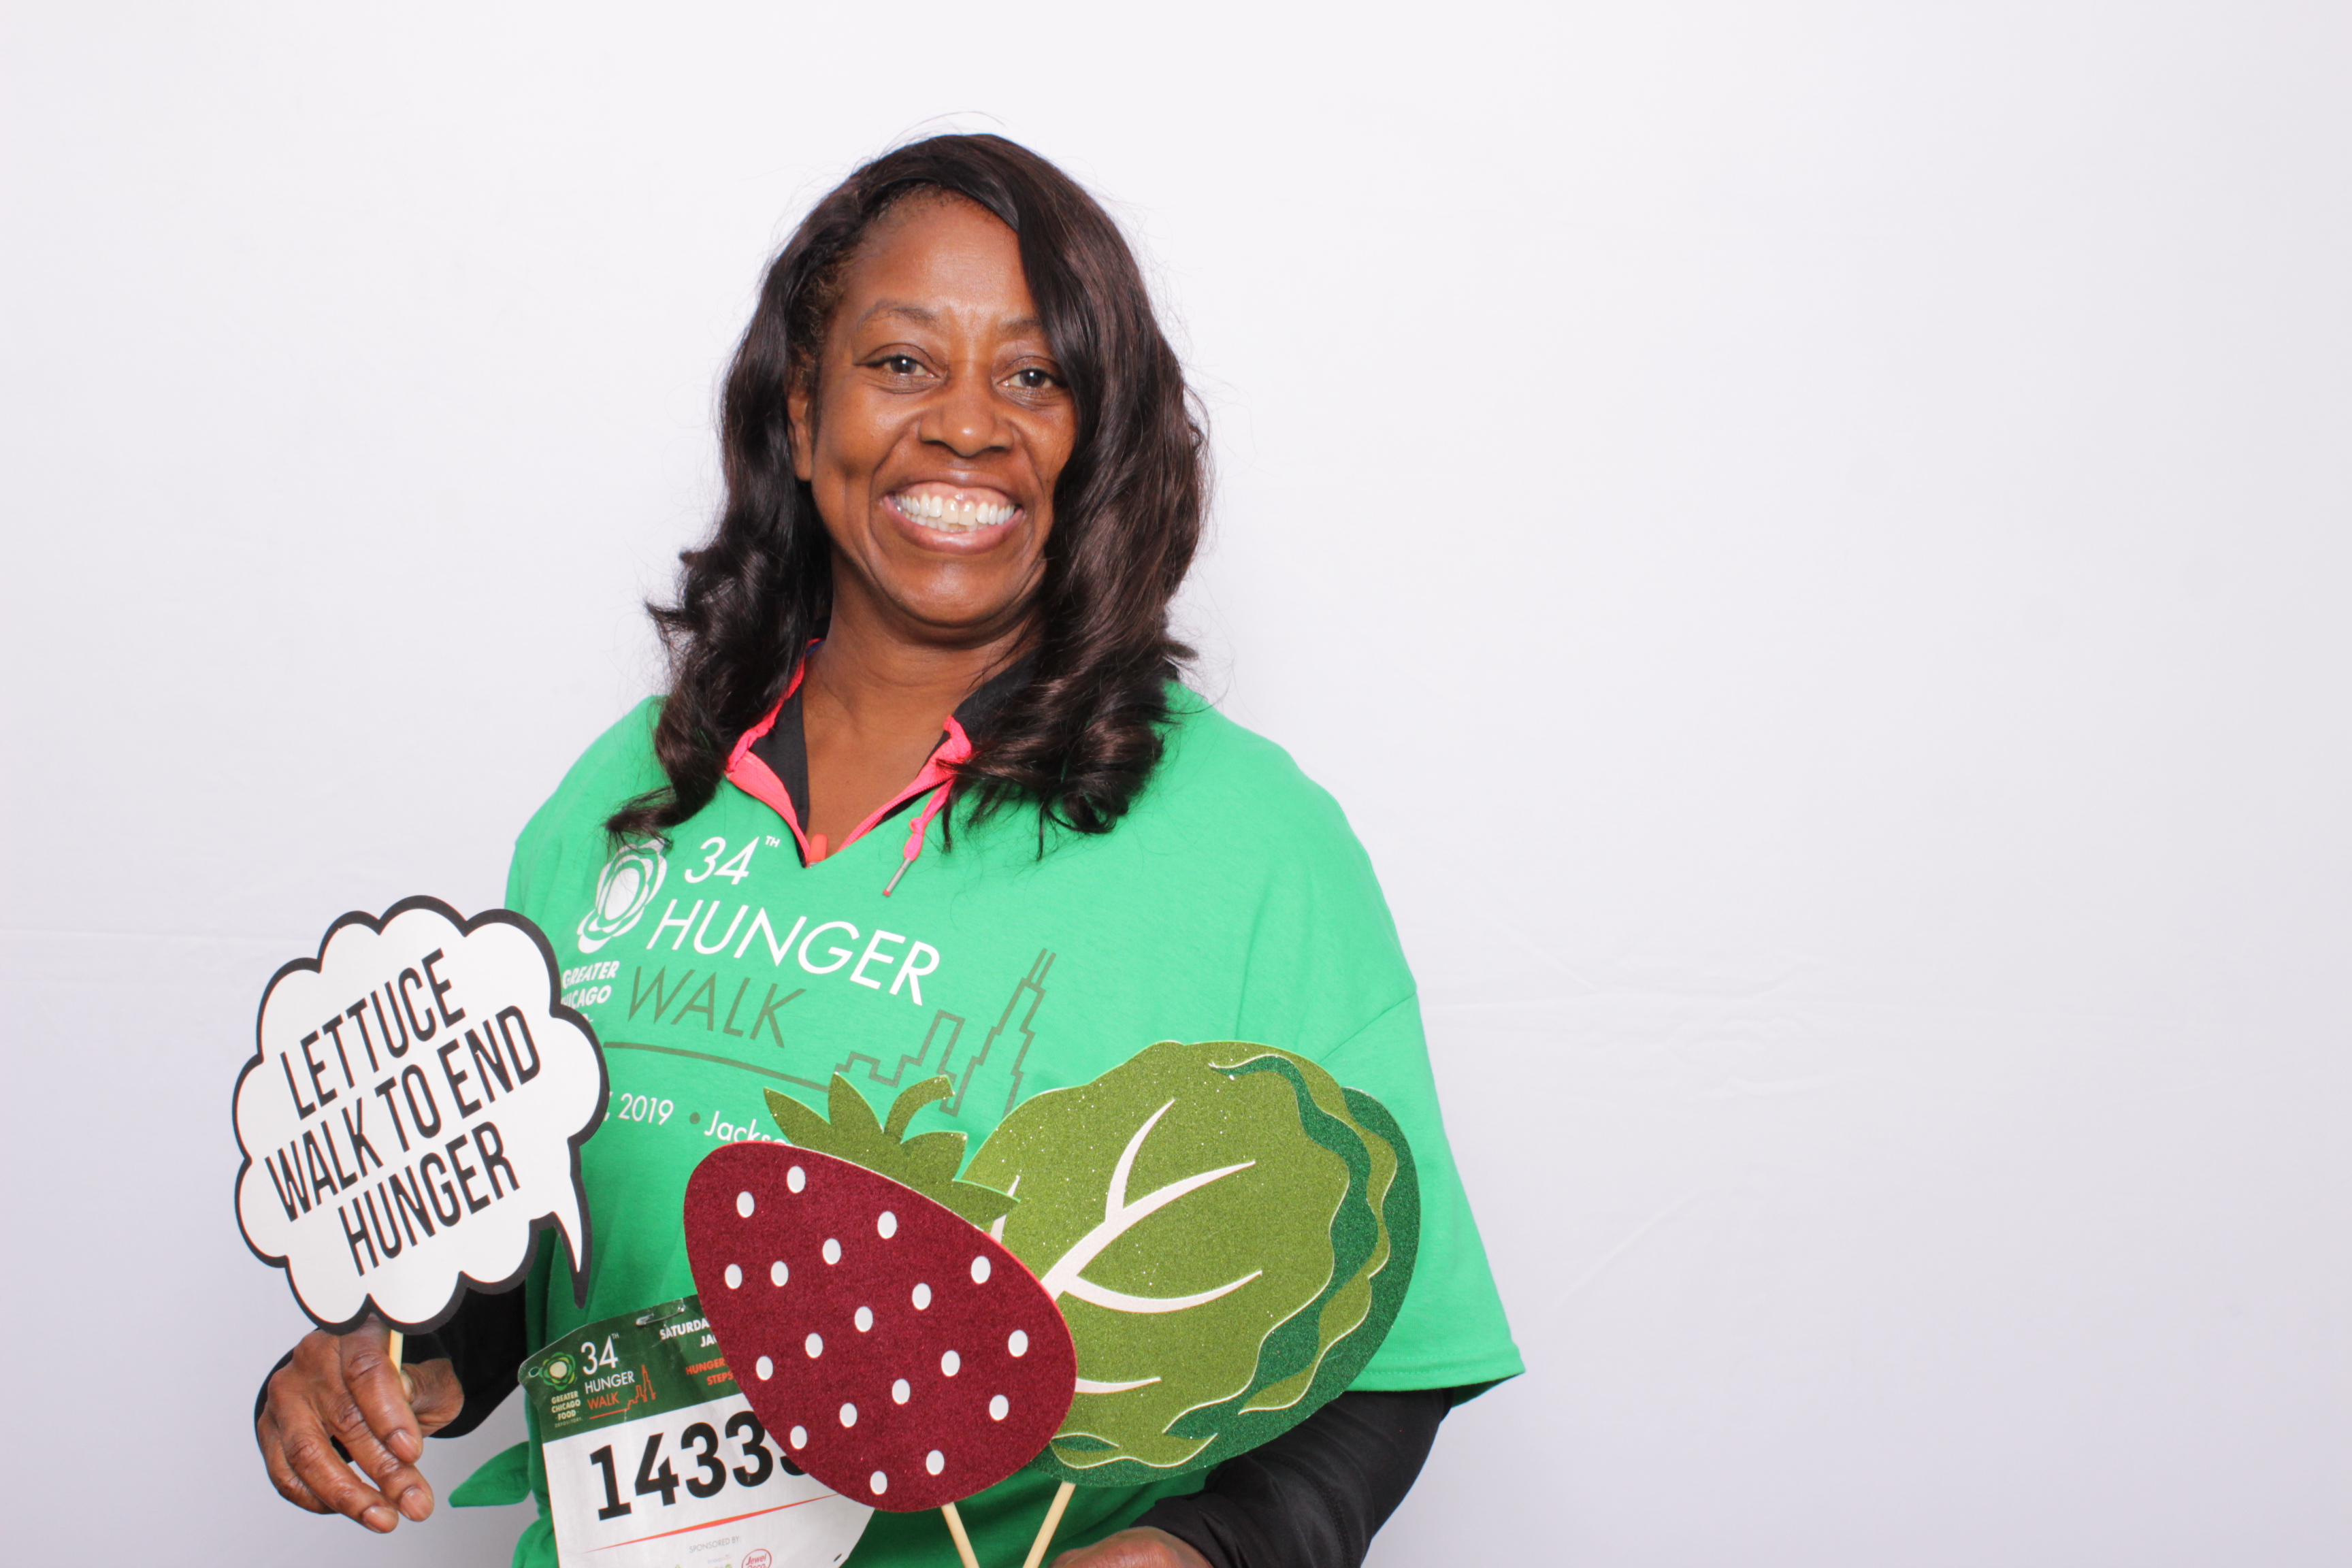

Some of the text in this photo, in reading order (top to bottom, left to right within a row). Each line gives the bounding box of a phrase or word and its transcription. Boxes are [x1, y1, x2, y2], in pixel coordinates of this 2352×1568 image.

[646, 898, 940, 1007] HUNGER
[561, 960, 620, 990] GREATER
[627, 965, 807, 1049] WALK
[280, 947, 466, 1120] LETTUCE
[264, 1005, 541, 1222] WALK TO END
[618, 1092, 674, 1126] 2019
[704, 1110, 789, 1145] Jack
[338, 1121, 521, 1277] HUNGER
[685, 1358, 726, 1375] HUNGER
[585, 1371, 635, 1394] HUNGER
[706, 1371, 734, 1386] STEPS
[551, 1390, 578, 1404] GREATER
[551, 1399, 581, 1413] CHICAGO
[587, 1392, 620, 1410] WALK
[557, 1409, 576, 1421] FOOD
[689, 1535, 742, 1553] SPONSORED BY:
[746, 1553, 767, 1566] Jewel
